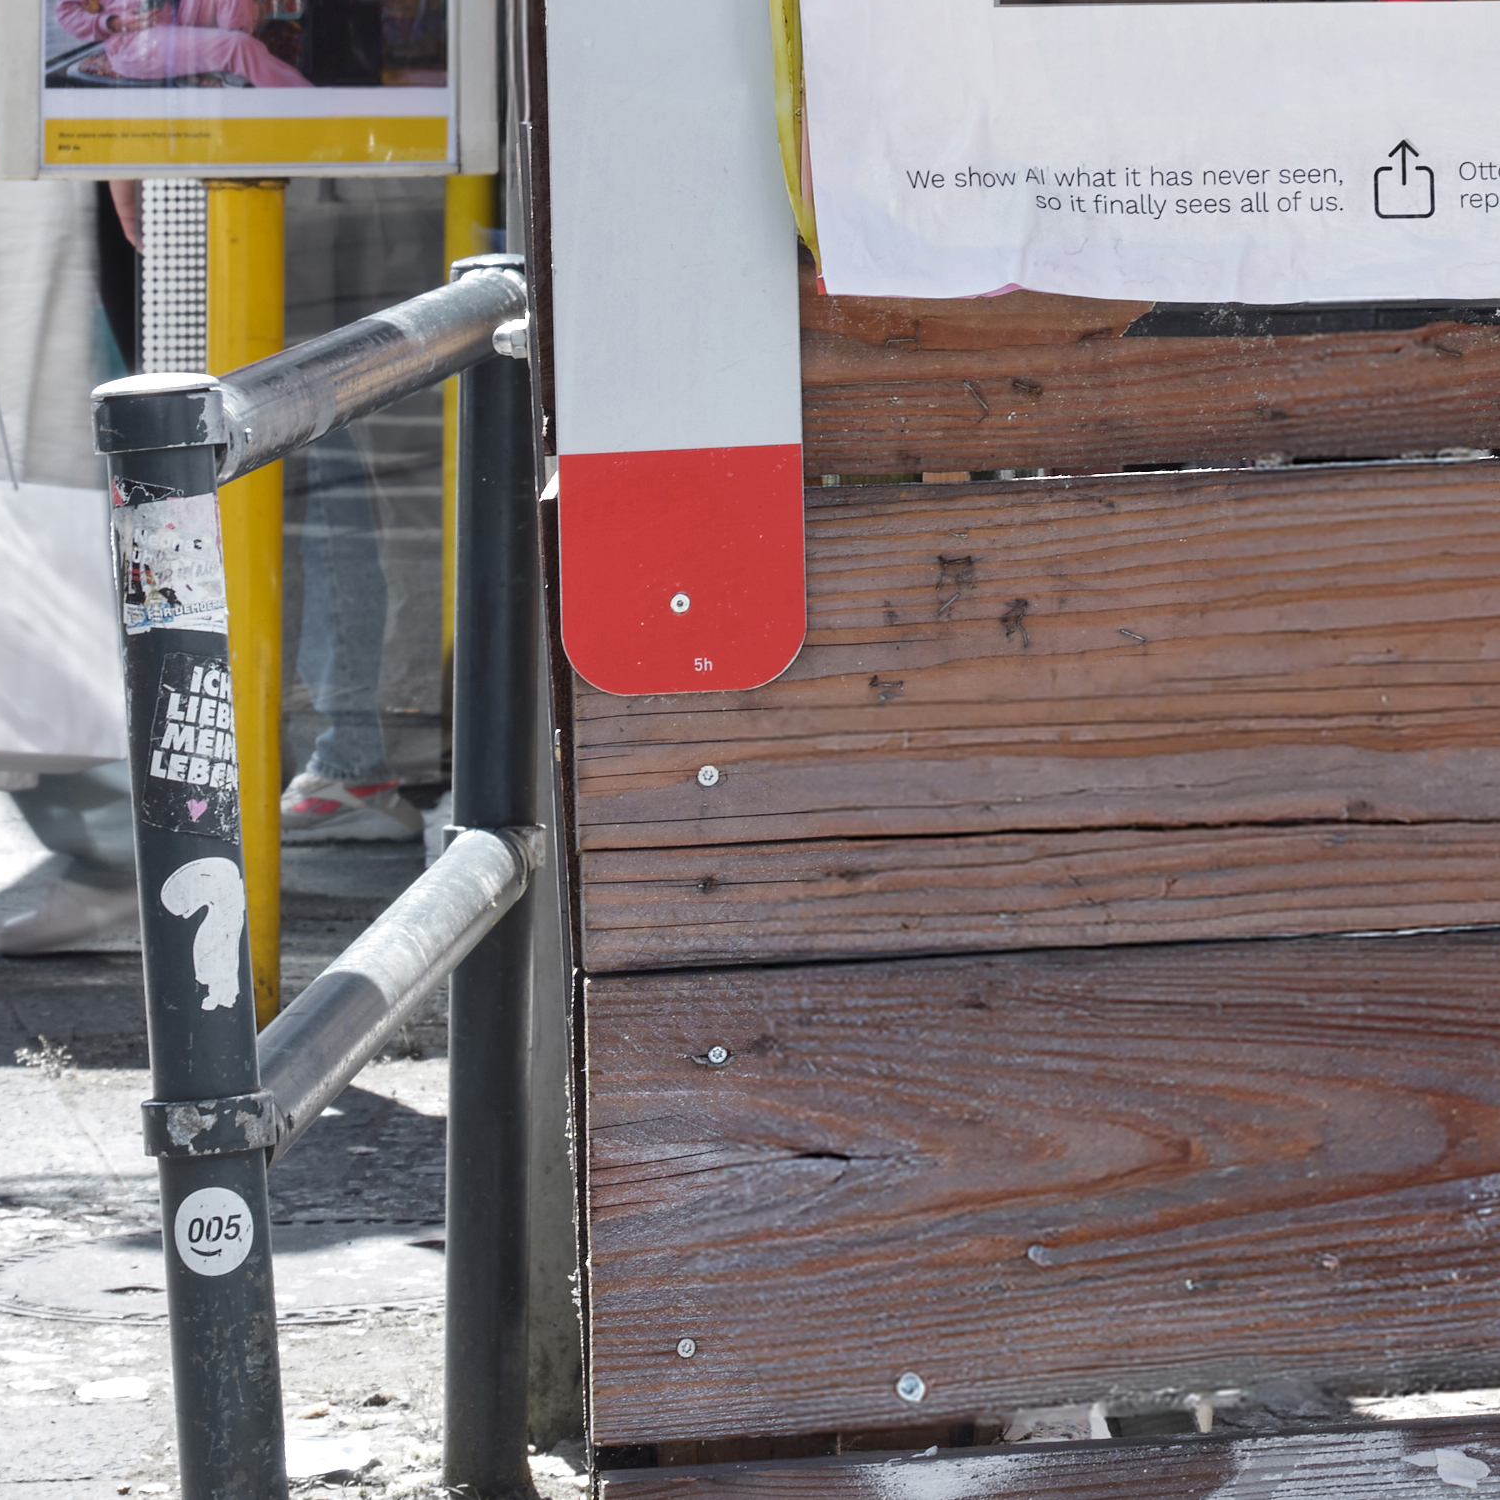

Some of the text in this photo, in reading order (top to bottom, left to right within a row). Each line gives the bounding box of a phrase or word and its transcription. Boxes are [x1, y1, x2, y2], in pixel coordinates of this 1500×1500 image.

[907, 166, 1342, 188] We show AI what it has never seen,
[1036, 191, 1343, 219] so it finally sees all of us.
[694, 657, 713, 671] 5h
[190, 666, 231, 699] ICH
[188, 1214, 241, 1243] 005
